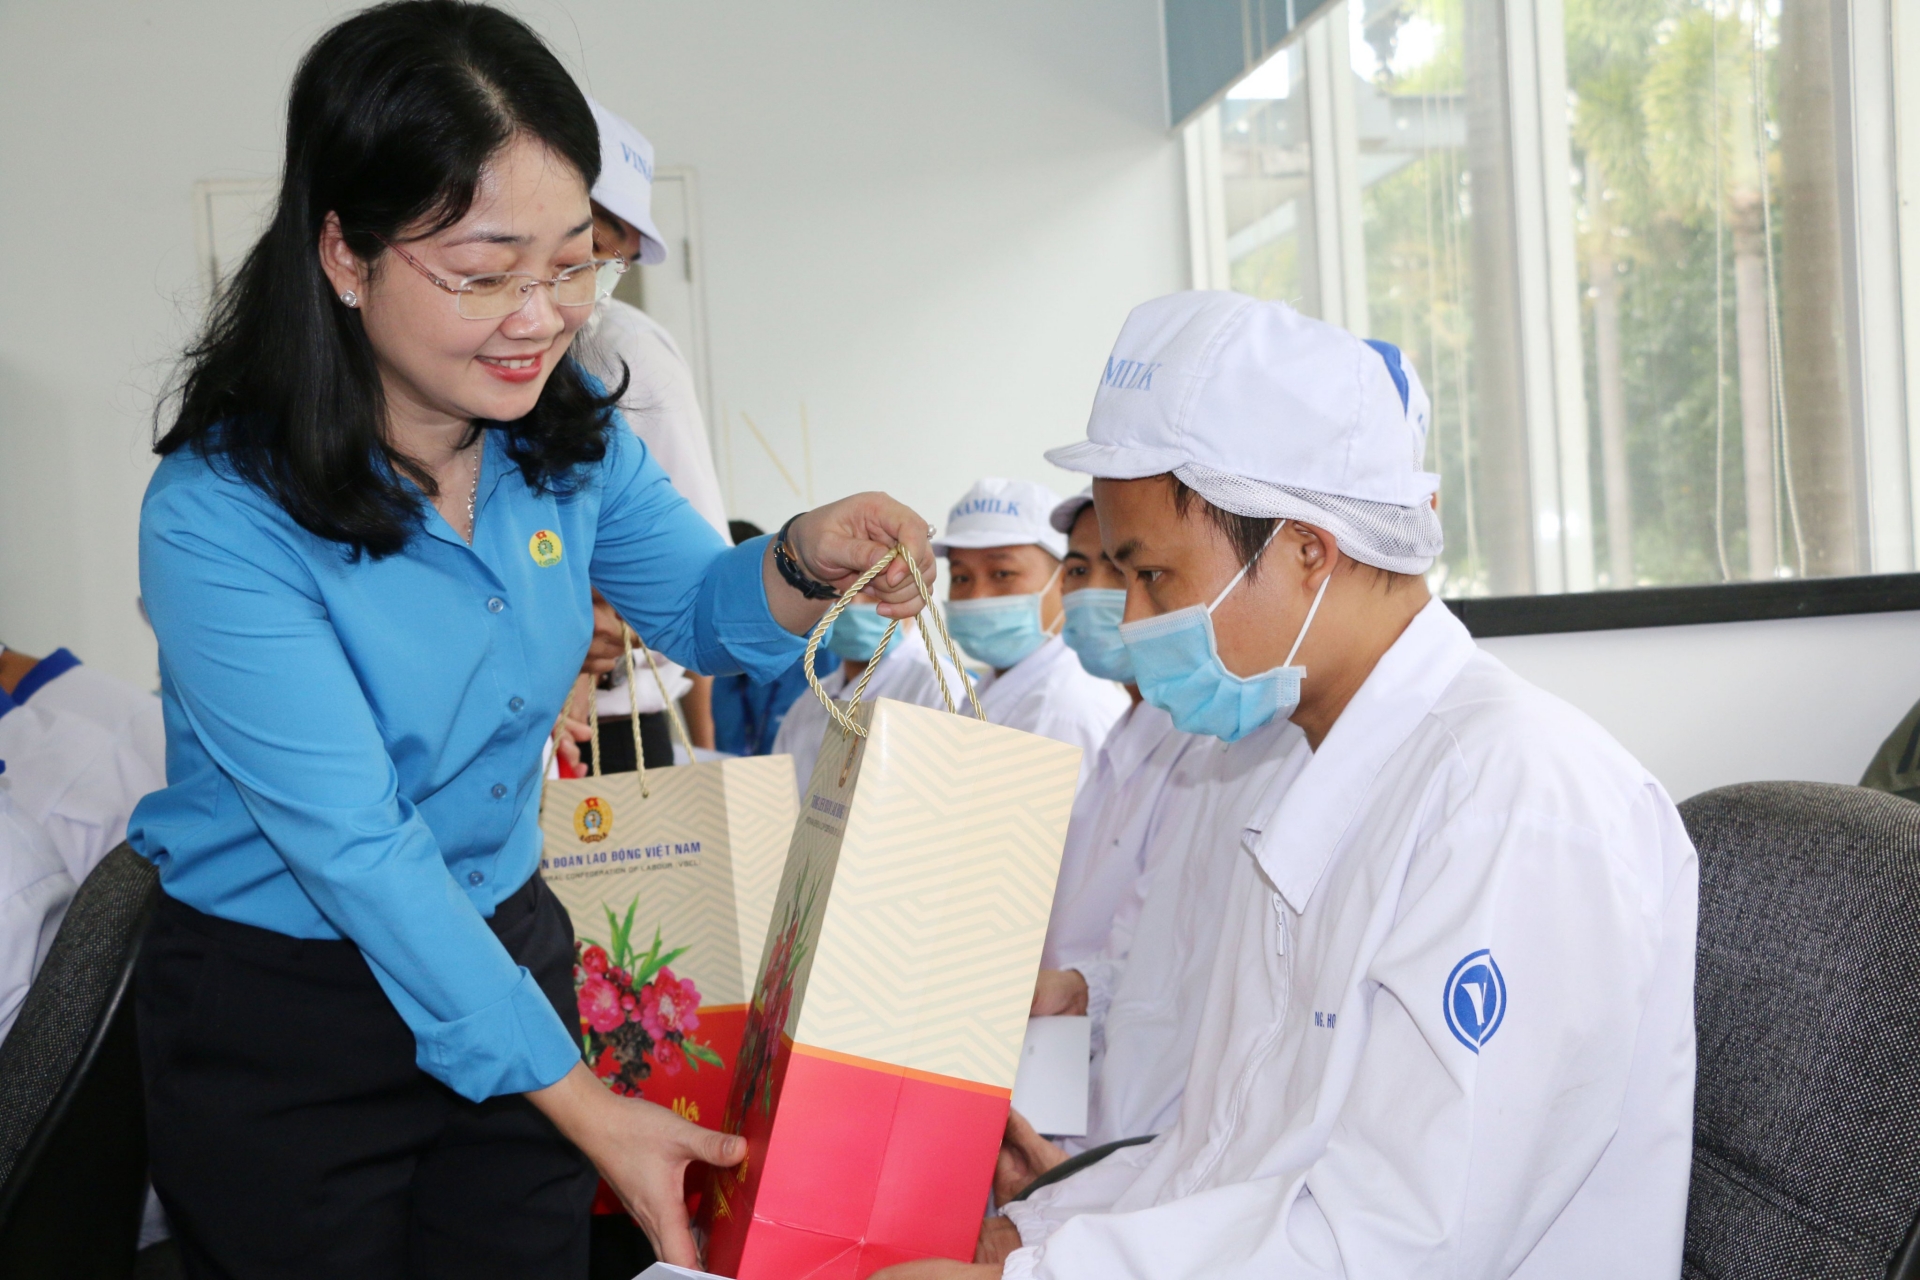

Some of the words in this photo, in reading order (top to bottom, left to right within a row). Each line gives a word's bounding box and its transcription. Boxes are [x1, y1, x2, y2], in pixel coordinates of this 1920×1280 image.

[587, 852, 607, 865] LAO
[611, 847, 641, 864] ĐỘNG
[645, 842, 671, 859] VIỆT
[675, 841, 701, 855] NAM
[628, 866, 639, 874] OF
[641, 862, 673, 873] LABOUR
